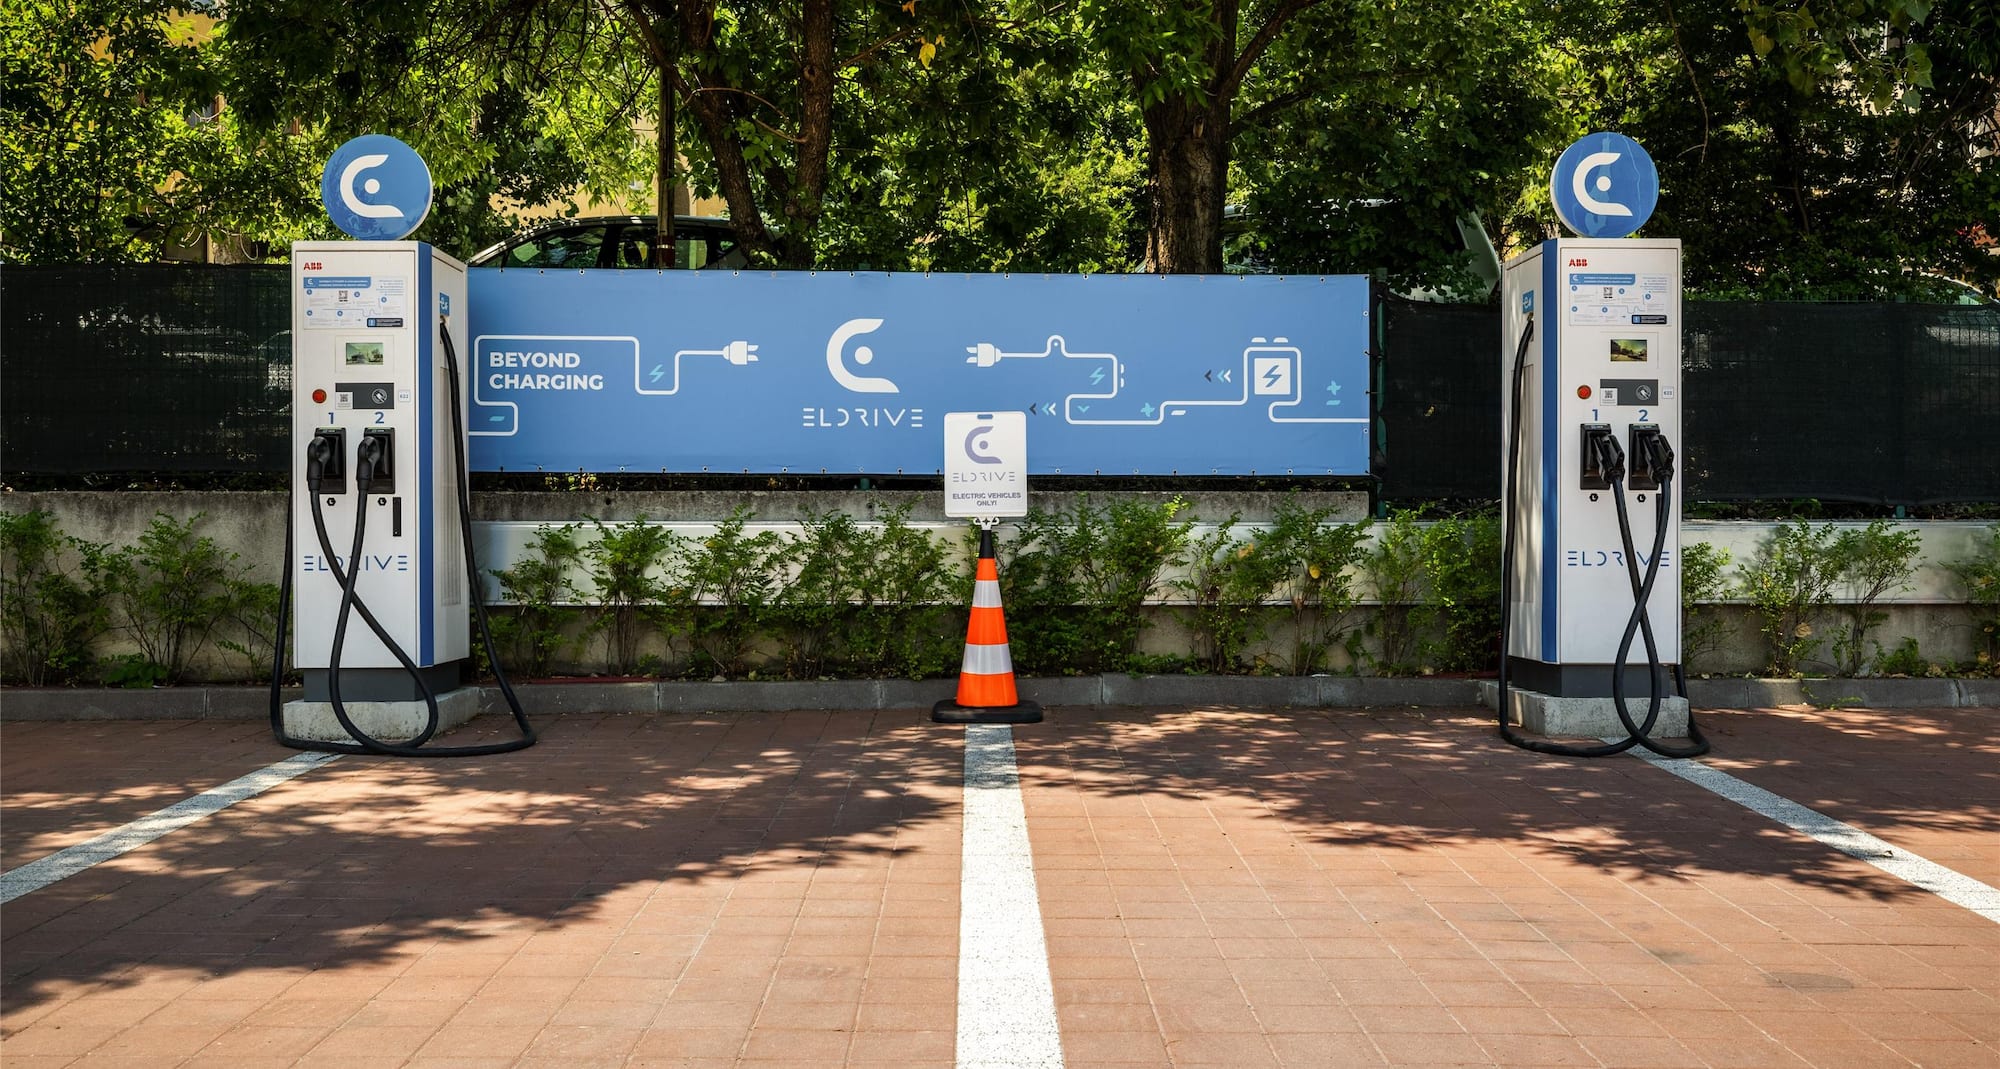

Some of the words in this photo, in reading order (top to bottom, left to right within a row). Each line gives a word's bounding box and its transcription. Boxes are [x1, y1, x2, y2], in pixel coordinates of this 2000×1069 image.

[303, 262, 323, 271] ABB
[1569, 259, 1588, 267] ABB
[490, 352, 580, 368] BEYOND
[489, 373, 604, 391] CHARGING
[328, 412, 334, 424] 1
[375, 411, 385, 424] 2
[803, 407, 923, 428] ELDRIVE
[1592, 409, 1598, 421] 1
[1639, 409, 1649, 421] 2
[952, 471, 1015, 482] ELDRIVE
[952, 492, 986, 500] ELECTRIC
[304, 555, 408, 571] ELDIVE
[1567, 551, 1670, 567] ELDRVE
